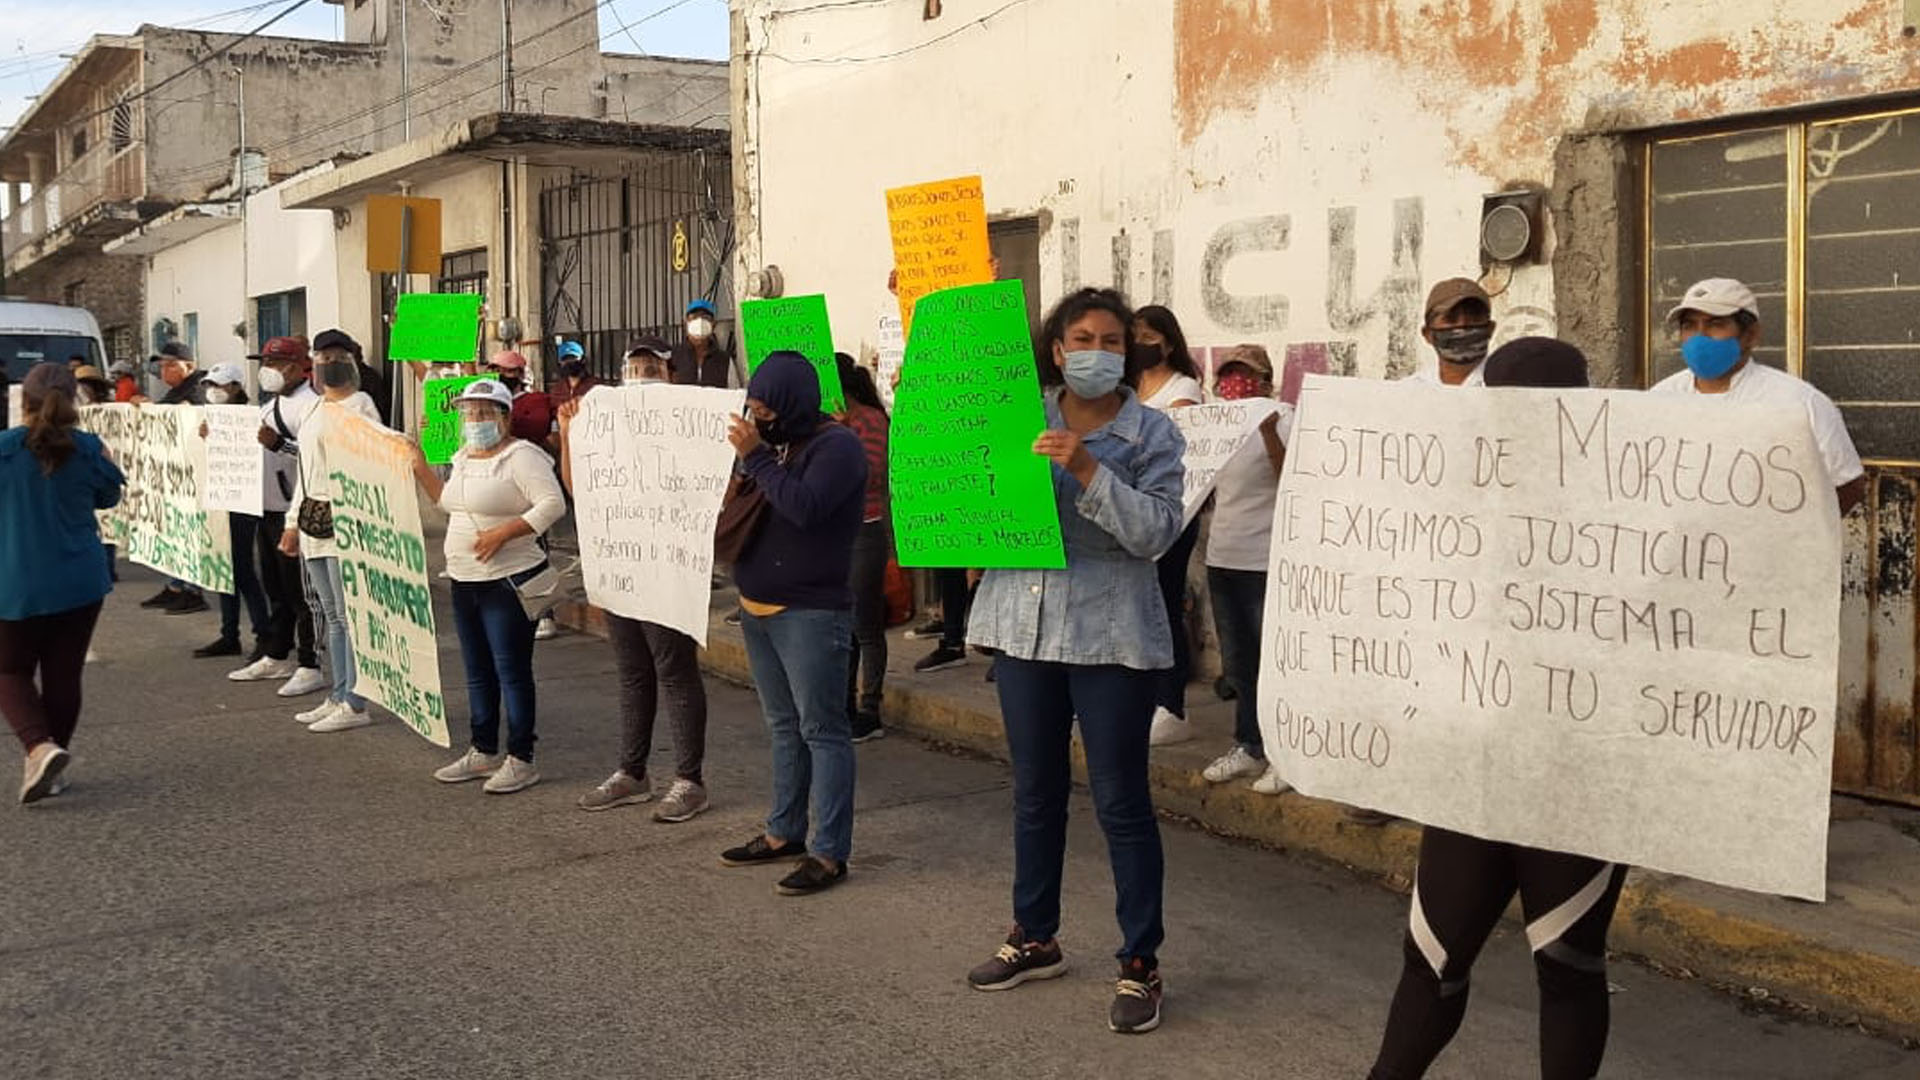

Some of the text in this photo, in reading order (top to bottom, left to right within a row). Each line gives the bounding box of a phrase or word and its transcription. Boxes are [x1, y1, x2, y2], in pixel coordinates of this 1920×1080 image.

[1293, 397, 1806, 514] ESTADO DE MORELOS
[342, 559, 358, 597] A
[1278, 489, 1737, 599] TE EXIGIMOS JUSTICIA,
[1277, 557, 1813, 660] PORQUE ES TU SISTEMA EL
[1274, 626, 1311, 678] QUE
[1532, 661, 1599, 722] TU
[1640, 683, 1818, 759] SERVIDOR
